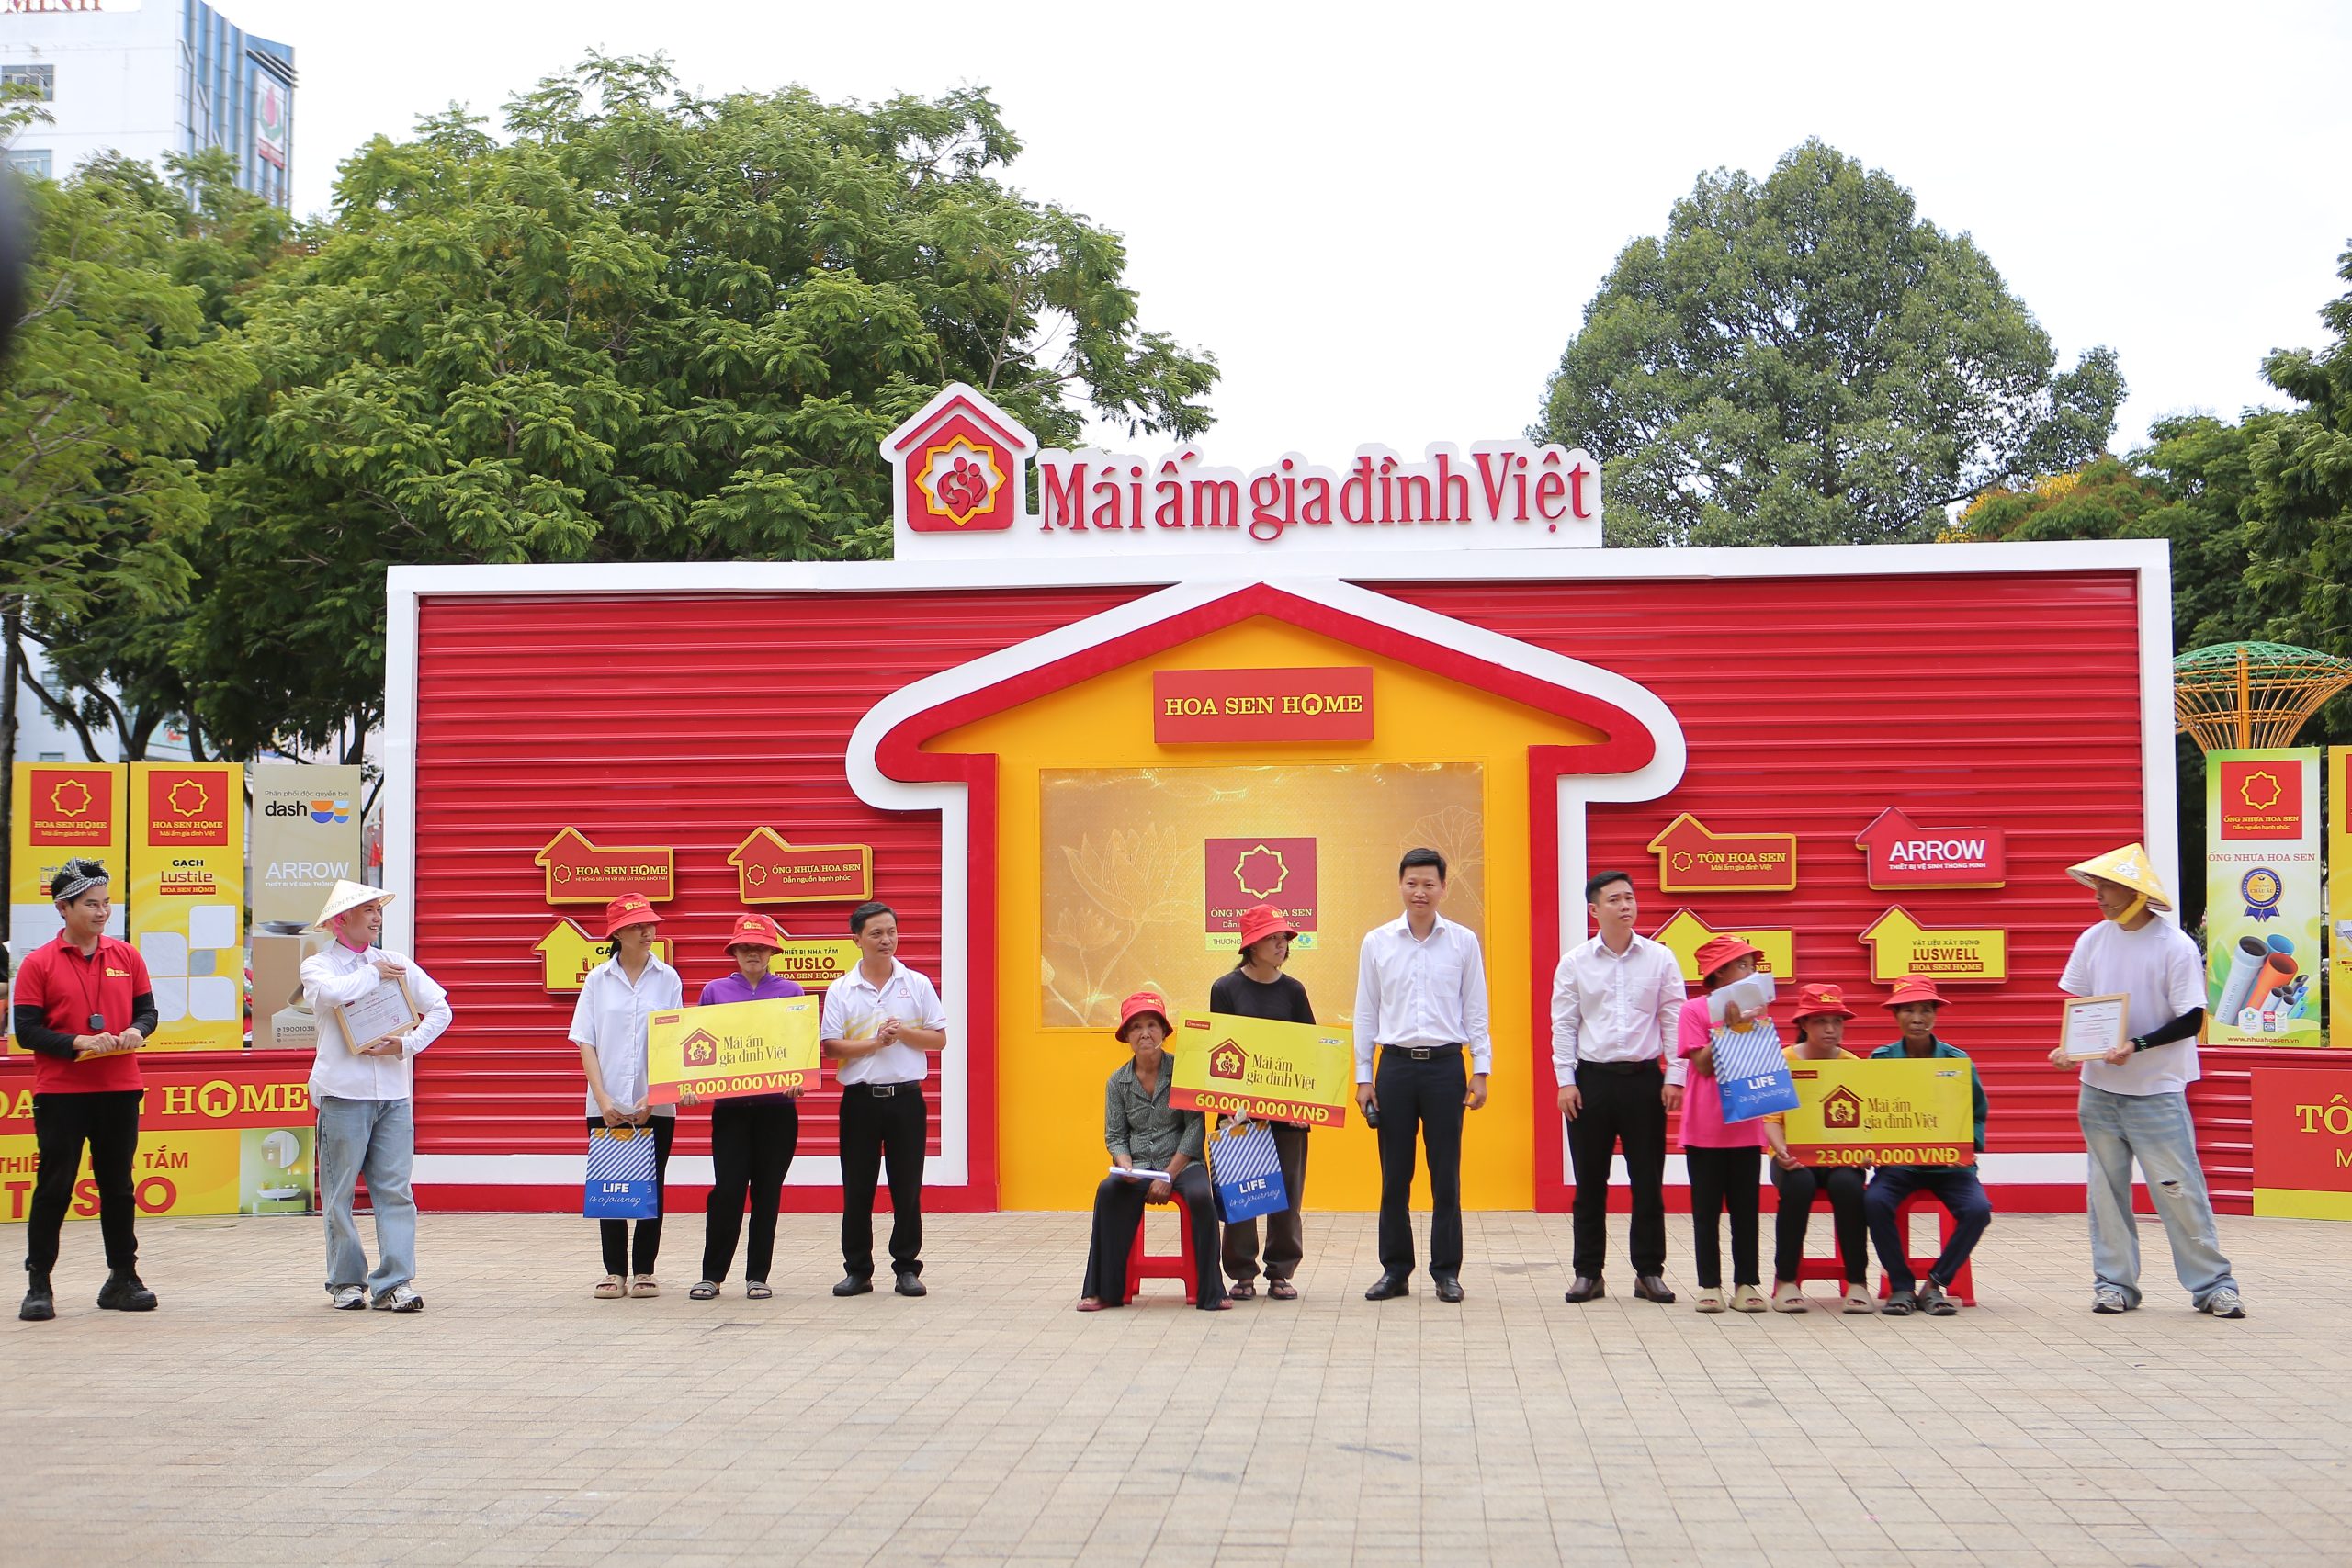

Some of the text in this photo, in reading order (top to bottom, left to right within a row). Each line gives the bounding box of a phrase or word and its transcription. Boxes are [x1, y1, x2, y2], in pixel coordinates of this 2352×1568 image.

[1039, 451, 1593, 542] Mái ấm gia đình Việt
[1164, 693, 1363, 716] HOA SEN HOME
[265, 801, 307, 816] dash
[1697, 850, 1786, 863] TÔN HOA SEN
[1889, 840, 1985, 861] ARROW
[2208, 851, 2231, 861] ỐNG
[2234, 854, 2264, 863] NHỰA
[172, 859, 204, 868] GẠCH
[265, 862, 349, 879] ARROW
[576, 865, 667, 876] HOA SEN HOME
[772, 864, 792, 874] ỐNG
[794, 865, 820, 874] NHỰA
[161, 871, 213, 882] Lustile
[1210, 906, 1233, 917] ỐNG
[1913, 948, 1979, 960] LUSWELL
[785, 957, 835, 970] TUSLO
[724, 1033, 763, 1050] Mái ấm
[720, 1052, 735, 1068] gia
[766, 1046, 787, 1061] Việt
[1252, 1054, 1292, 1072] Mái ấm
[677, 1072, 804, 1095] 18.000.000 VNĐ
[1246, 1070, 1263, 1086] gia
[1294, 1073, 1316, 1091] Việt
[1747, 1075, 1777, 1090] LIFE
[161, 1080, 308, 1118] HOME
[1868, 1097, 1911, 1113] Mái ấm
[1196, 1093, 1329, 1122] 60.000.000 VNĐ
[1864, 1115, 1881, 1132] gia
[1914, 1113, 1938, 1130] Việt
[143, 1145, 189, 1169] TẮM
[1816, 1148, 1960, 1164] 23.000.000 VNĐ
[602, 1183, 630, 1193] LIFE
[1239, 1178, 1266, 1194] LIFE
[4, 1176, 177, 1219] TSO
[602, 1196, 642, 1207] journey
